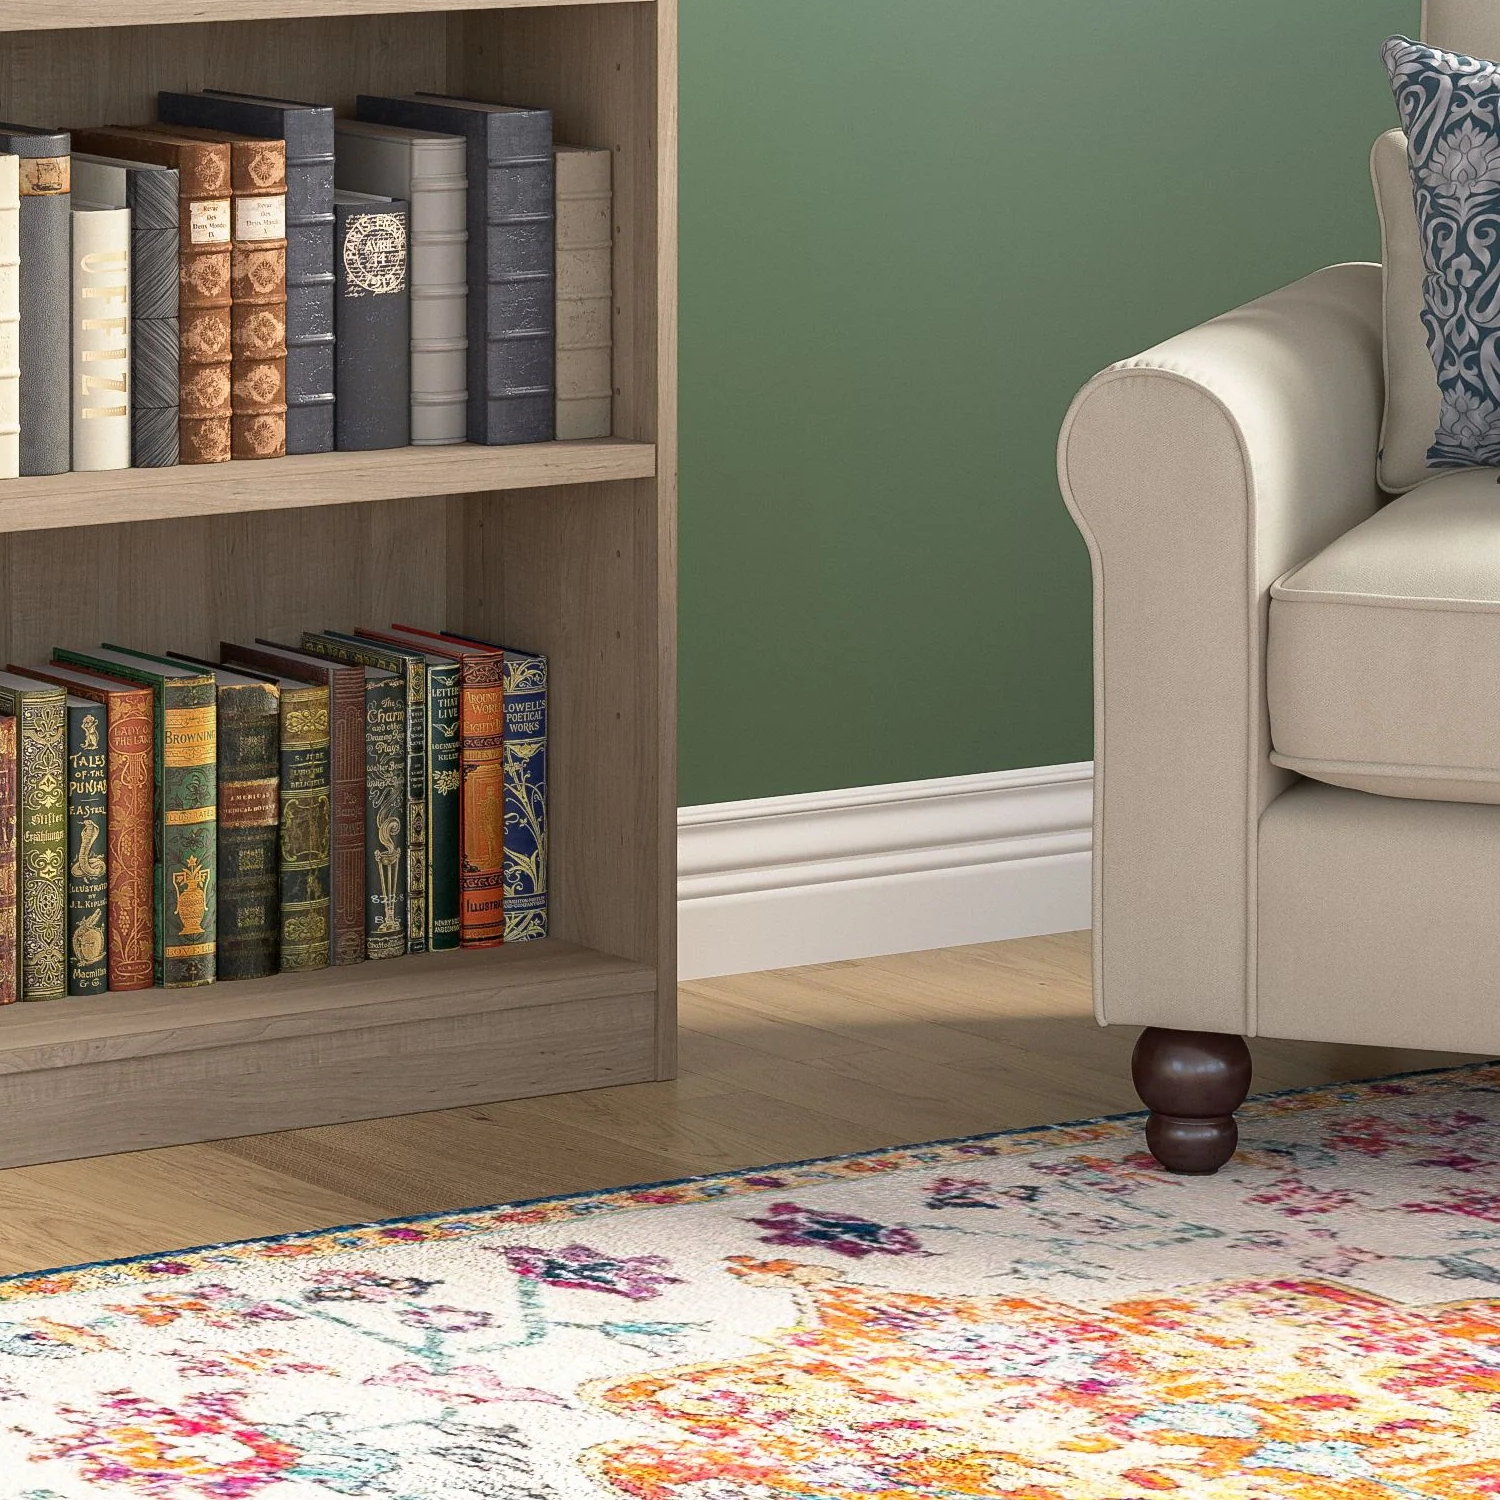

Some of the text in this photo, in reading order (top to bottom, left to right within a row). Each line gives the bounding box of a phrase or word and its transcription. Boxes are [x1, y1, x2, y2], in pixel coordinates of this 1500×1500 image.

[432, 687, 459, 698] LETTER
[465, 691, 498, 705] AROUND
[381, 697, 396, 708] The
[437, 698, 459, 709] THAT
[503, 699, 547, 714] LOWELL'S
[438, 709, 459, 719] LIVE
[506, 710, 544, 723] POETICAL
[114, 725, 141, 737] LADY
[371, 723, 386, 733] and
[508, 721, 541, 734] WORKS
[114, 736, 133, 747] THE
[164, 729, 216, 746] BROWNING
[365, 731, 393, 744] Drawing
[375, 740, 401, 756] Plays
[70, 751, 106, 769] TALES
[437, 752, 459, 761] KELLY
